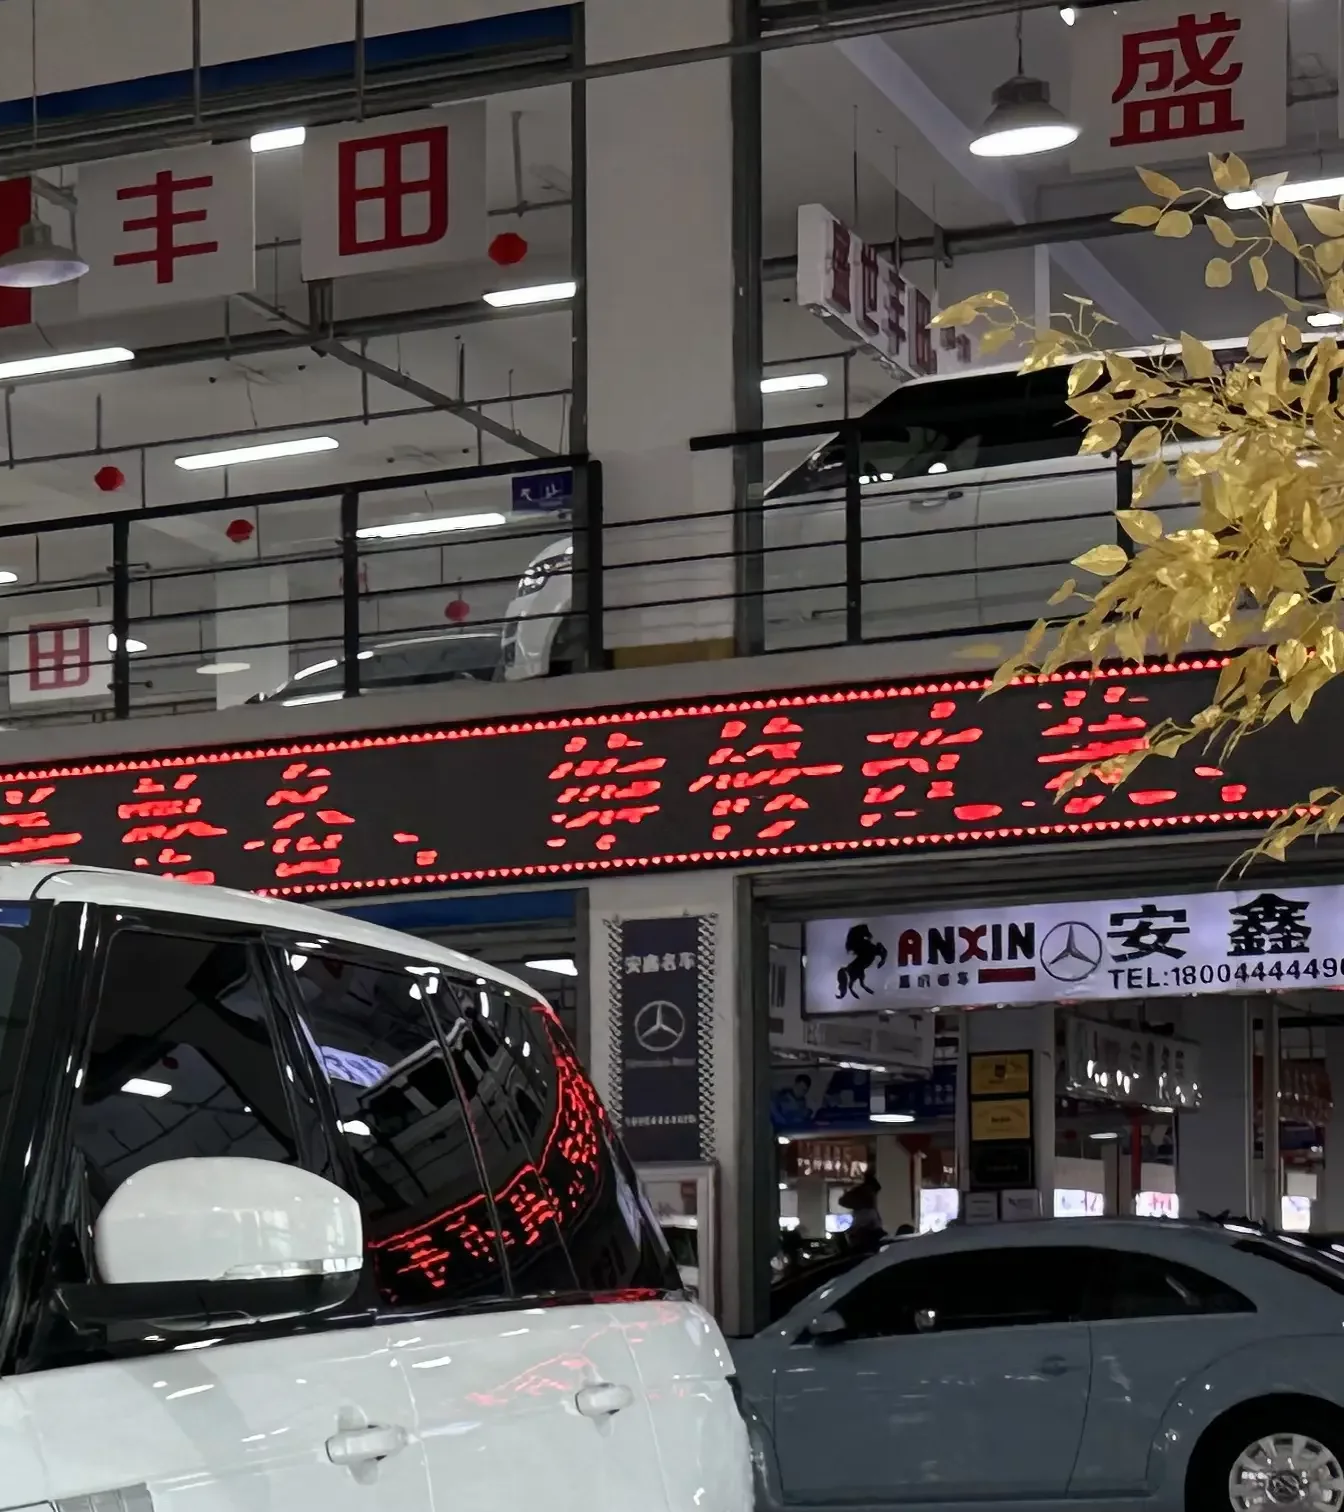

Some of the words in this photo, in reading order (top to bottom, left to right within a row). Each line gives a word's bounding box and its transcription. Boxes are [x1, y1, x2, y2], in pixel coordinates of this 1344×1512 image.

[1109, 11, 1245, 148] 盛
[336, 124, 449, 257] 田
[114, 170, 220, 285] 丰
[28, 619, 92, 692] 田
[897, 922, 1036, 967] ANXIN
[1106, 893, 1312, 963] 安鑫
[1107, 956, 1344, 990] TEL:1800444449
